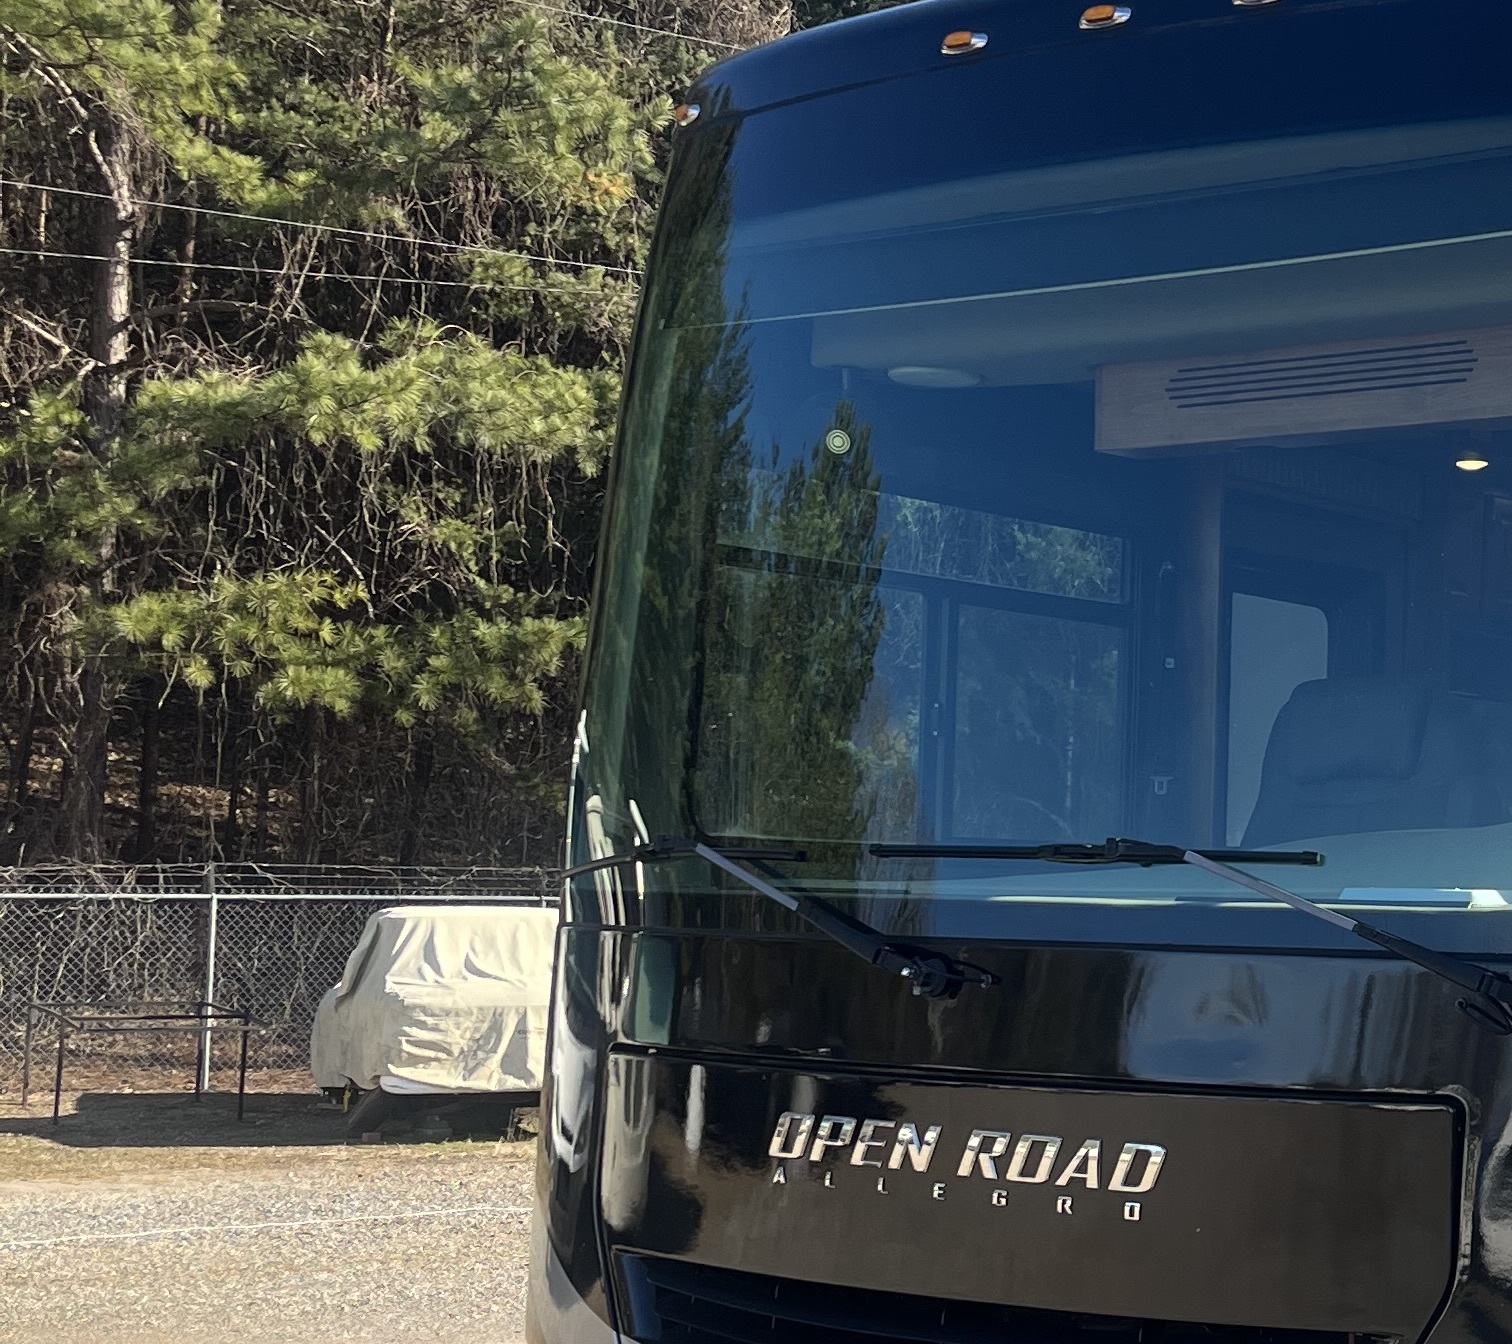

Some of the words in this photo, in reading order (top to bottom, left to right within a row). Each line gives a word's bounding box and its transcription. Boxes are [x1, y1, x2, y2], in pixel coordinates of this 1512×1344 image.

[768, 1110, 943, 1173] OPEN
[956, 1129, 1168, 1194] ROAD
[772, 1165, 1142, 1222] ALLEGRO
